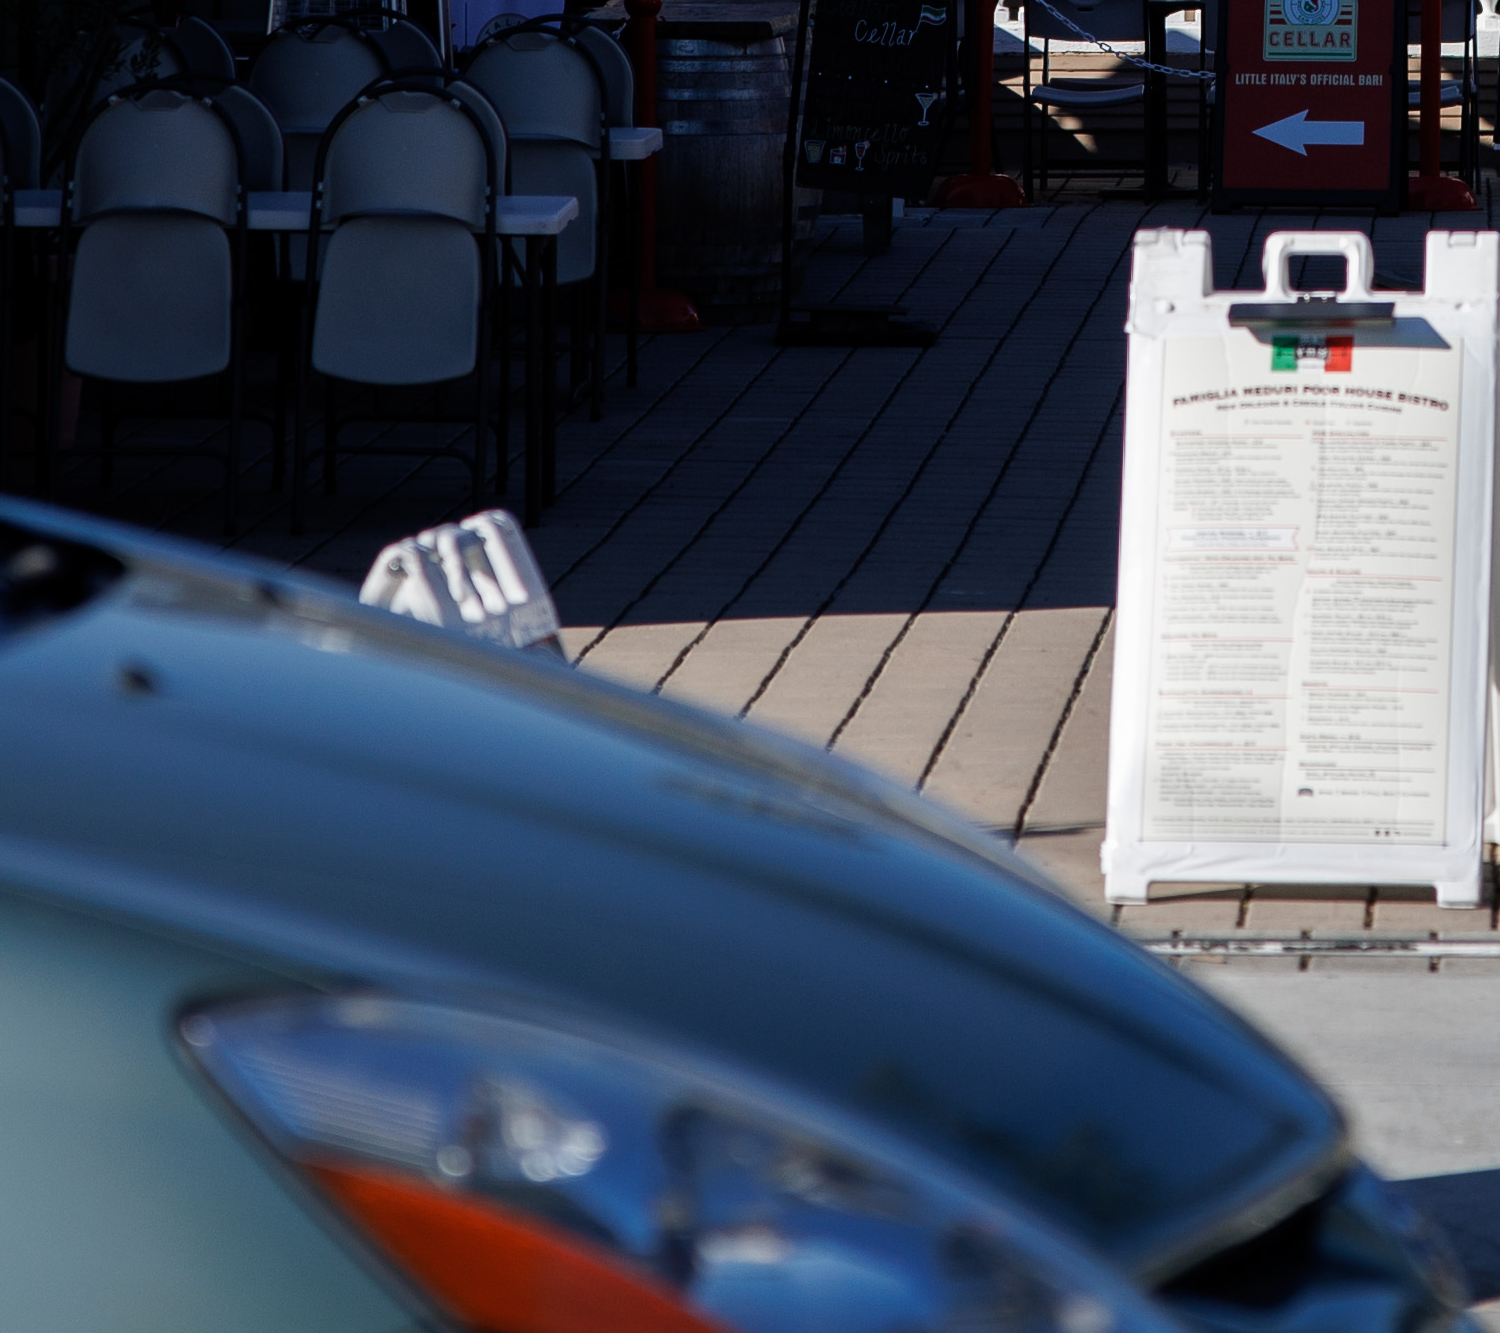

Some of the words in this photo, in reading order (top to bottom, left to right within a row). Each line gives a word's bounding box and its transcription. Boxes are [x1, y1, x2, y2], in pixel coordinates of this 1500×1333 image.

[854, 20, 914, 46] Cellar
[1269, 32, 1350, 47] CELLAR
[1235, 74, 1267, 85] LITTLE
[1270, 74, 1307, 85] ITALY'S
[1310, 74, 1355, 86] OFFICIAL
[1358, 74, 1383, 86] BAR!
